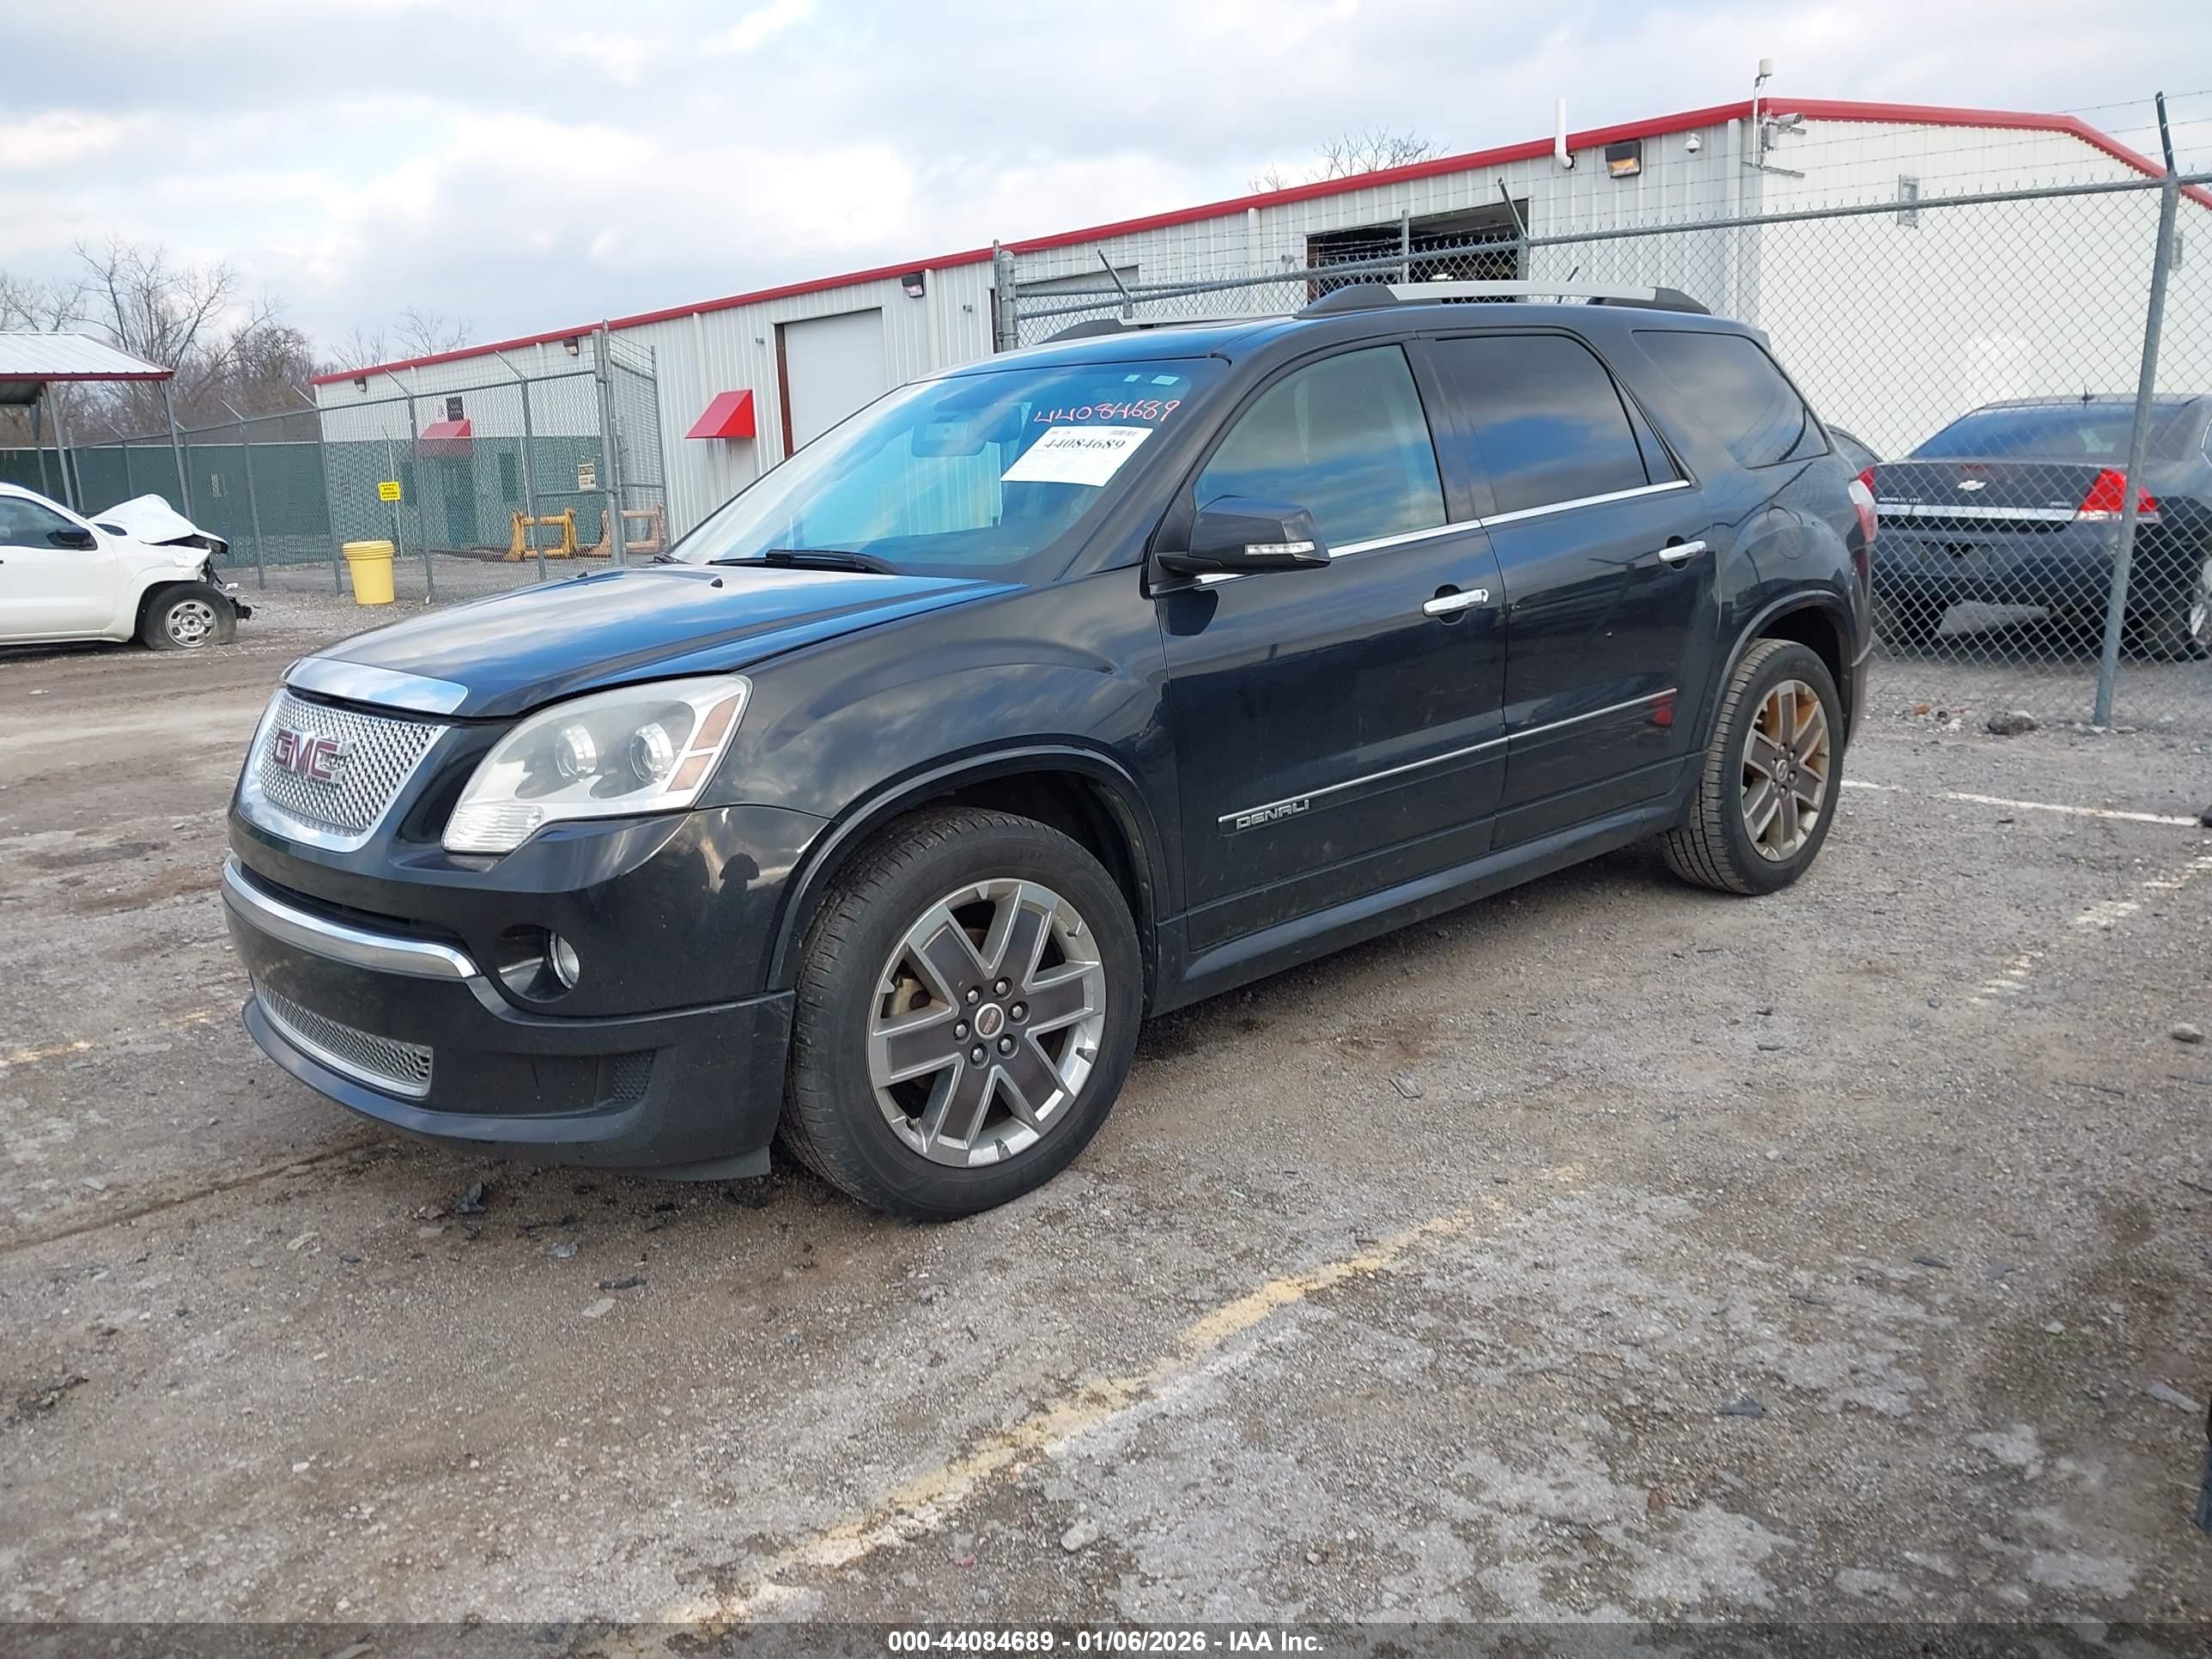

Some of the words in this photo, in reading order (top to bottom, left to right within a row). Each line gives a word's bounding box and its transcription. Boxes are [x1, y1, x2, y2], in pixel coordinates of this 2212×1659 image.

[1033, 399, 1182, 423] 44084689
[1043, 438, 1127, 450] 44084689
[274, 727, 340, 781] GMC
[1236, 799, 1310, 830] DENALI
